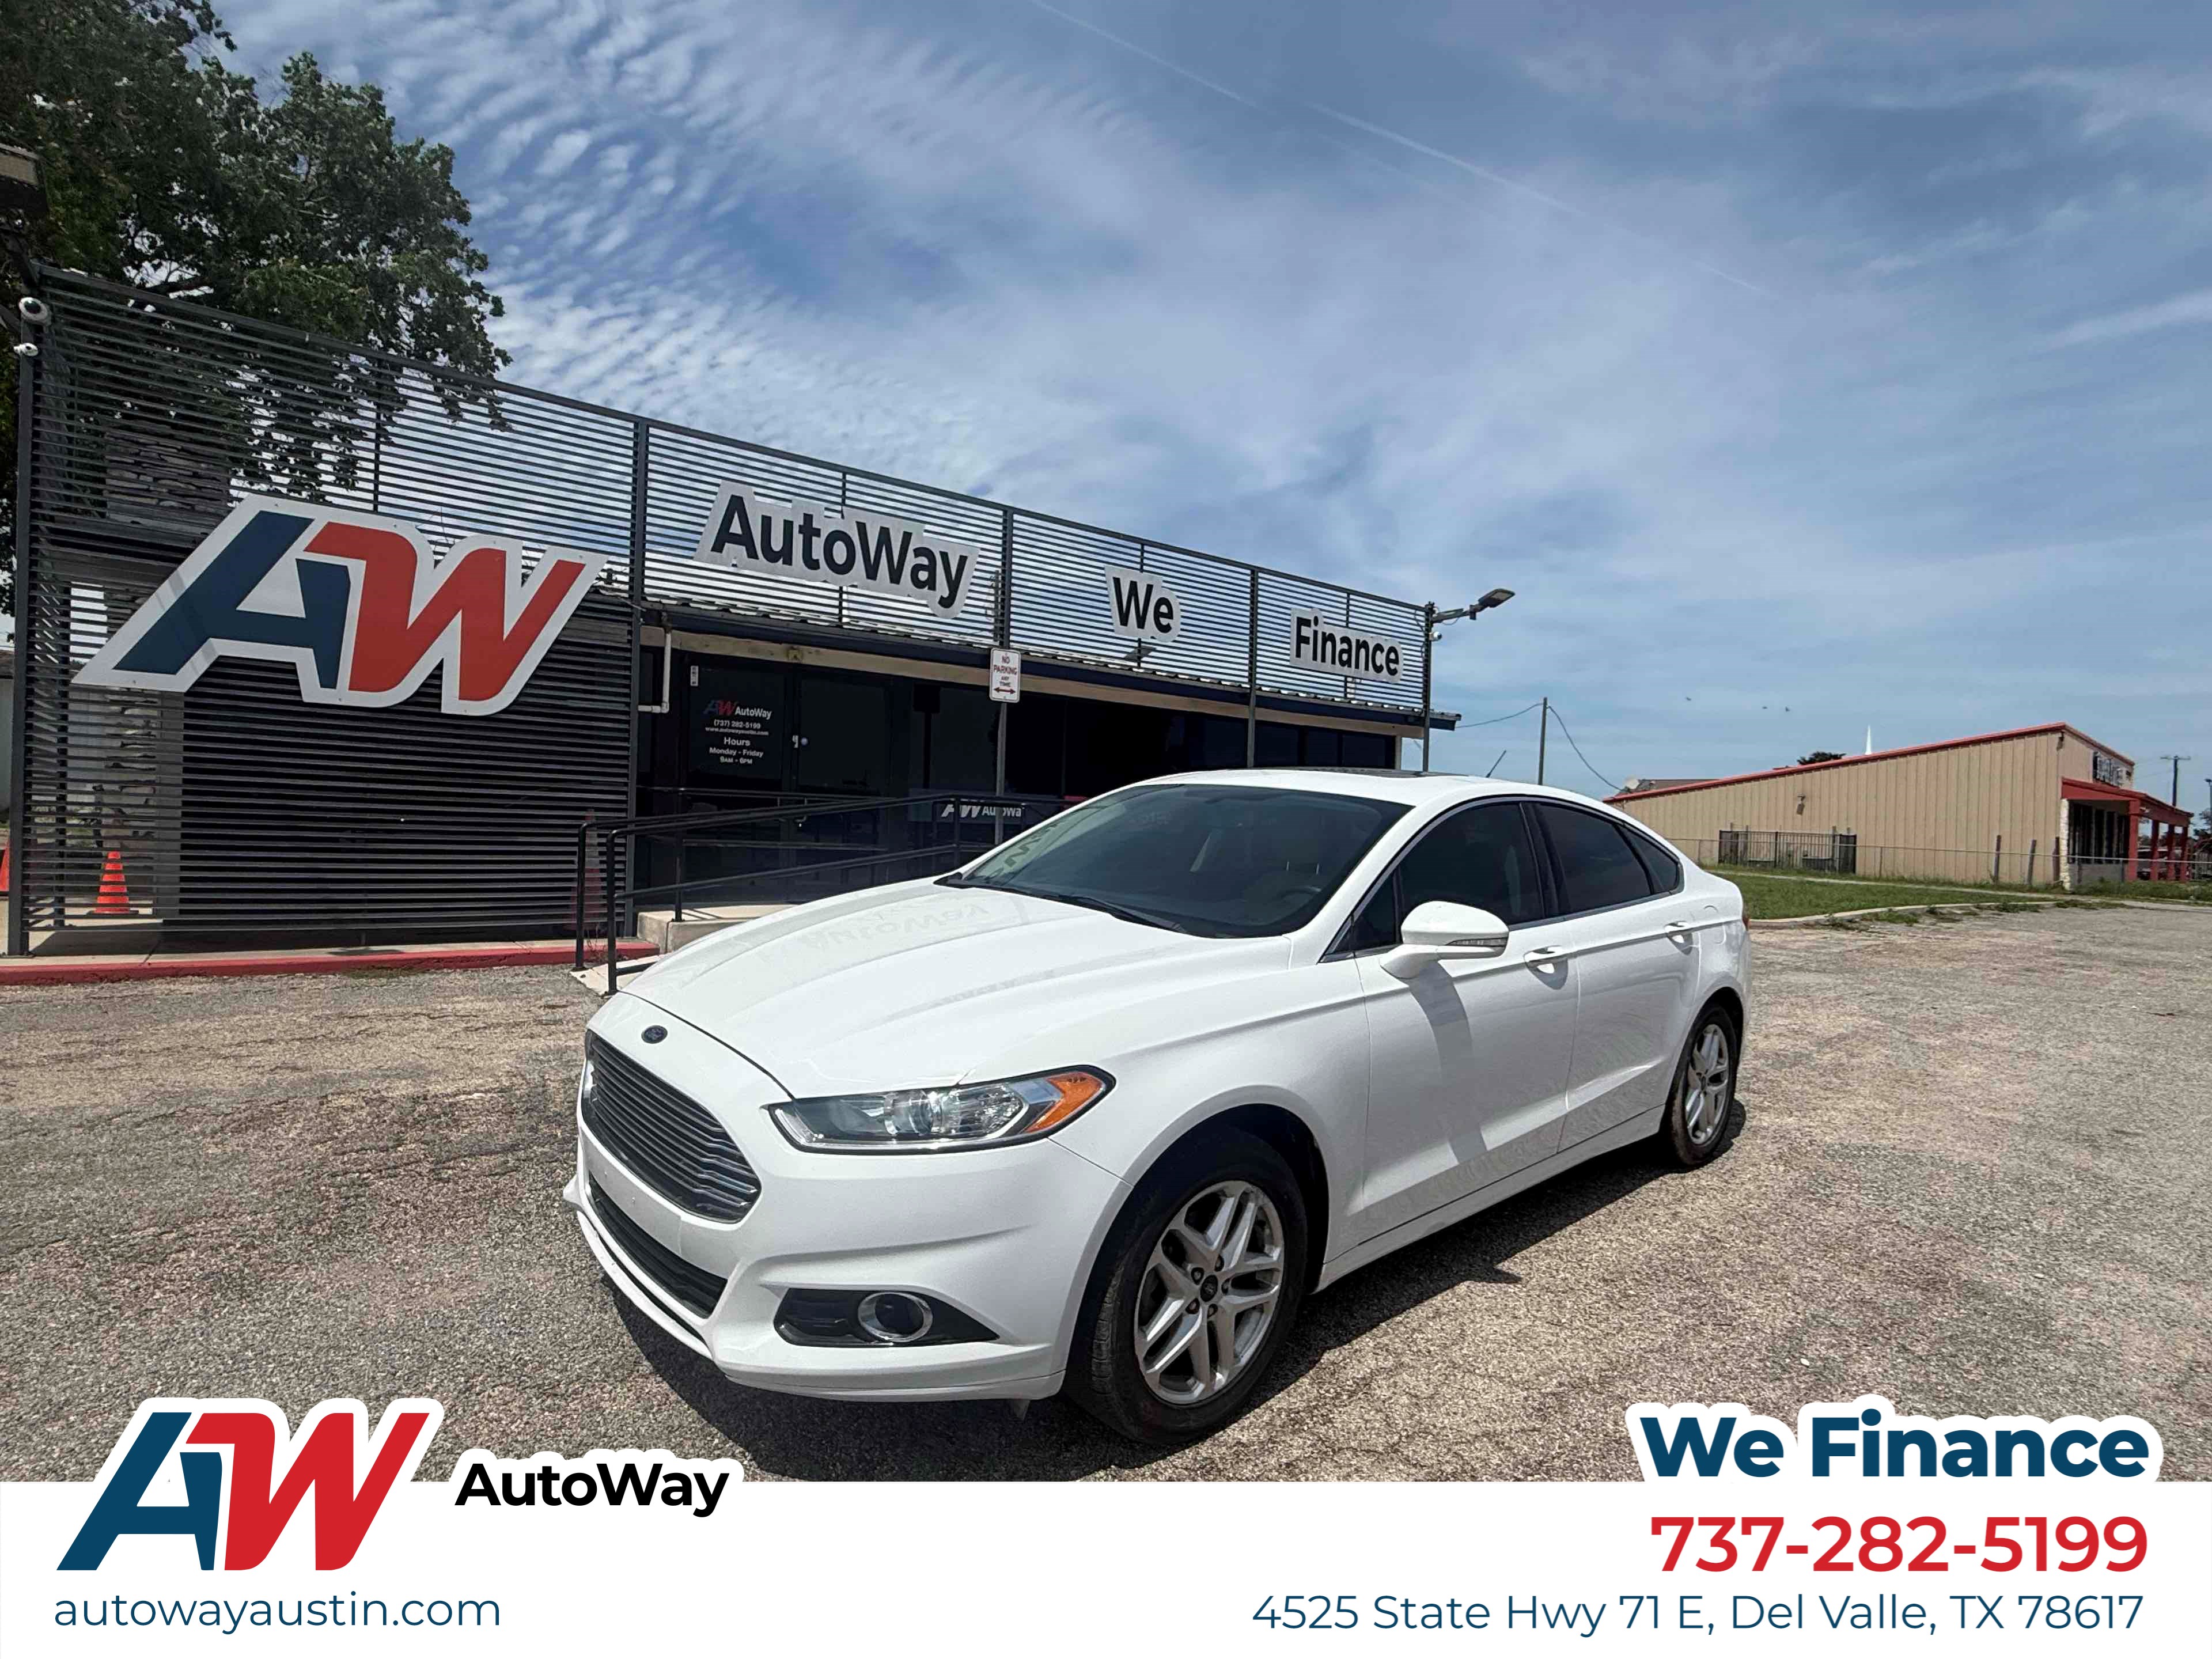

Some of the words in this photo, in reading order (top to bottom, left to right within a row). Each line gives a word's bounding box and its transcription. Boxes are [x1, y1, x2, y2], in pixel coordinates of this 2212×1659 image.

[710, 494, 968, 609] AutoWay
[111, 510, 586, 700] AW
[1112, 577, 1174, 633] We
[1296, 616, 1399, 676] Finance
[1001, 656, 1010, 664] NO
[993, 665, 1017, 675] PARKING
[735, 706, 772, 719] AutoWay
[714, 719, 730, 727] (737)
[724, 737, 751, 746] Hours
[709, 747, 737, 756] Monday
[743, 749, 764, 758] Friday
